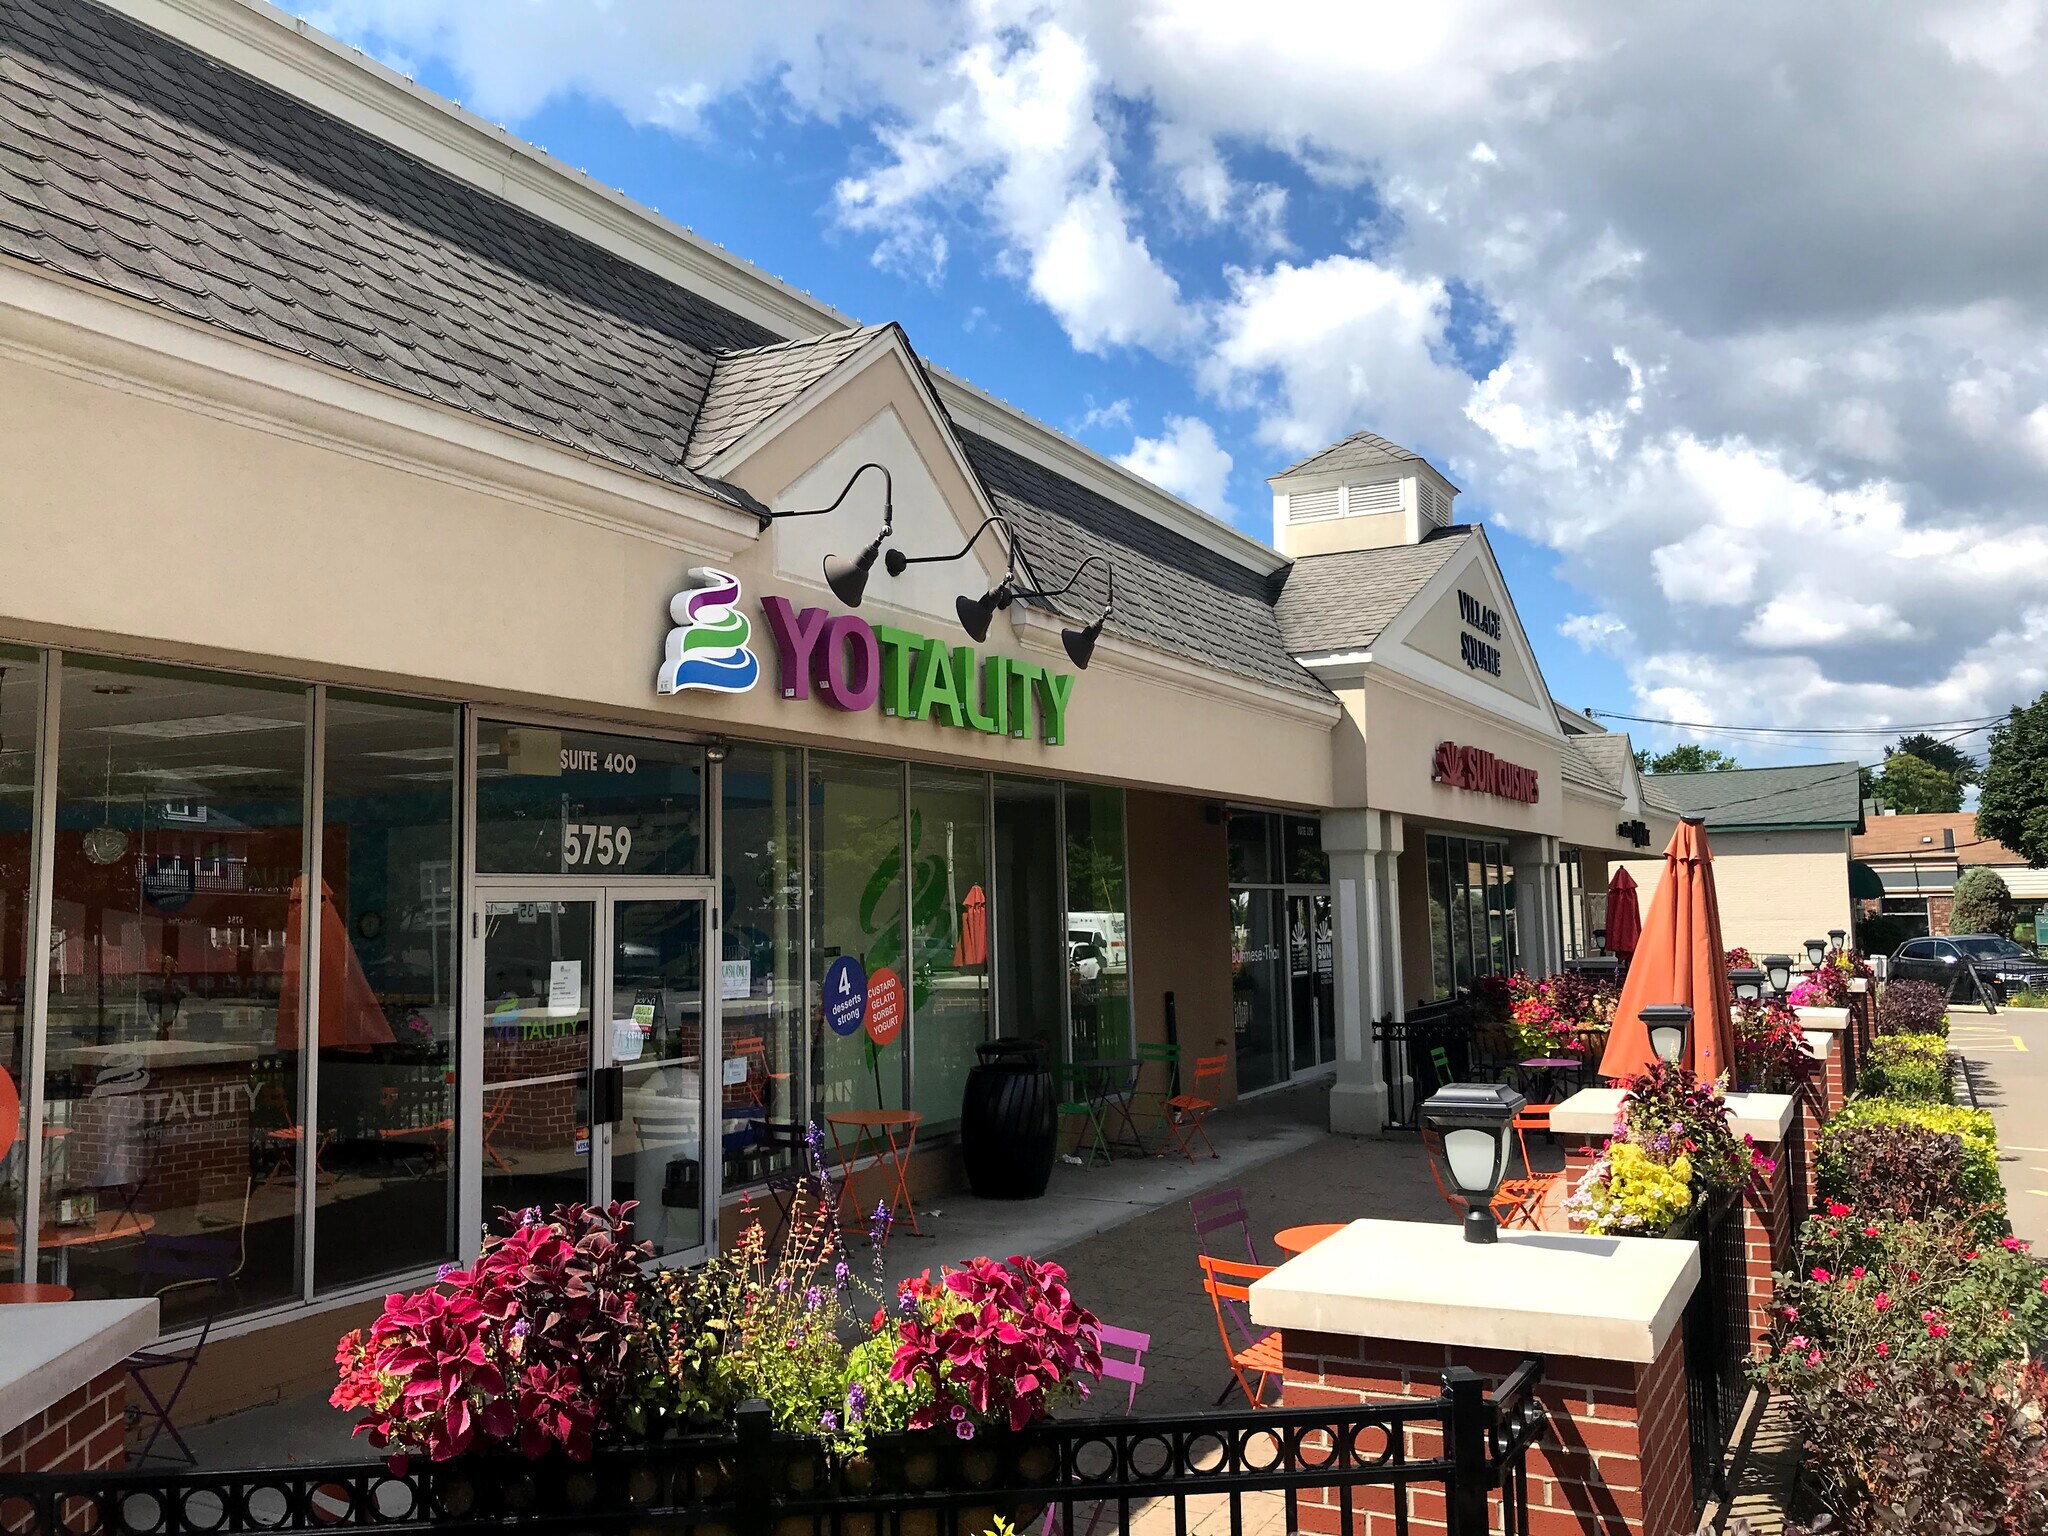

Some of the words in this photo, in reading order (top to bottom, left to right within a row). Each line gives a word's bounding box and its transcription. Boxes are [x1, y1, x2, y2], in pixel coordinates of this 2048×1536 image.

[1457, 589, 1501, 640] VILLAGE
[1461, 631, 1501, 677] SQUARE
[760, 596, 1075, 746] YOTALITY
[560, 749, 598, 772] SUITE
[604, 753, 637, 774] 400
[1462, 746, 1495, 793] SUN
[1495, 759, 1539, 803] CUISINES
[563, 824, 632, 866] 5759
[838, 966, 851, 996] 4
[867, 978, 896, 999] CUSTARD
[832, 994, 862, 1016] desserts
[871, 991, 896, 1010] GELATO
[872, 1002, 897, 1023] SORBET
[837, 1007, 860, 1026] strong
[873, 1015, 899, 1035] YOGURT
[494, 1019, 579, 1043] YOTALITY
